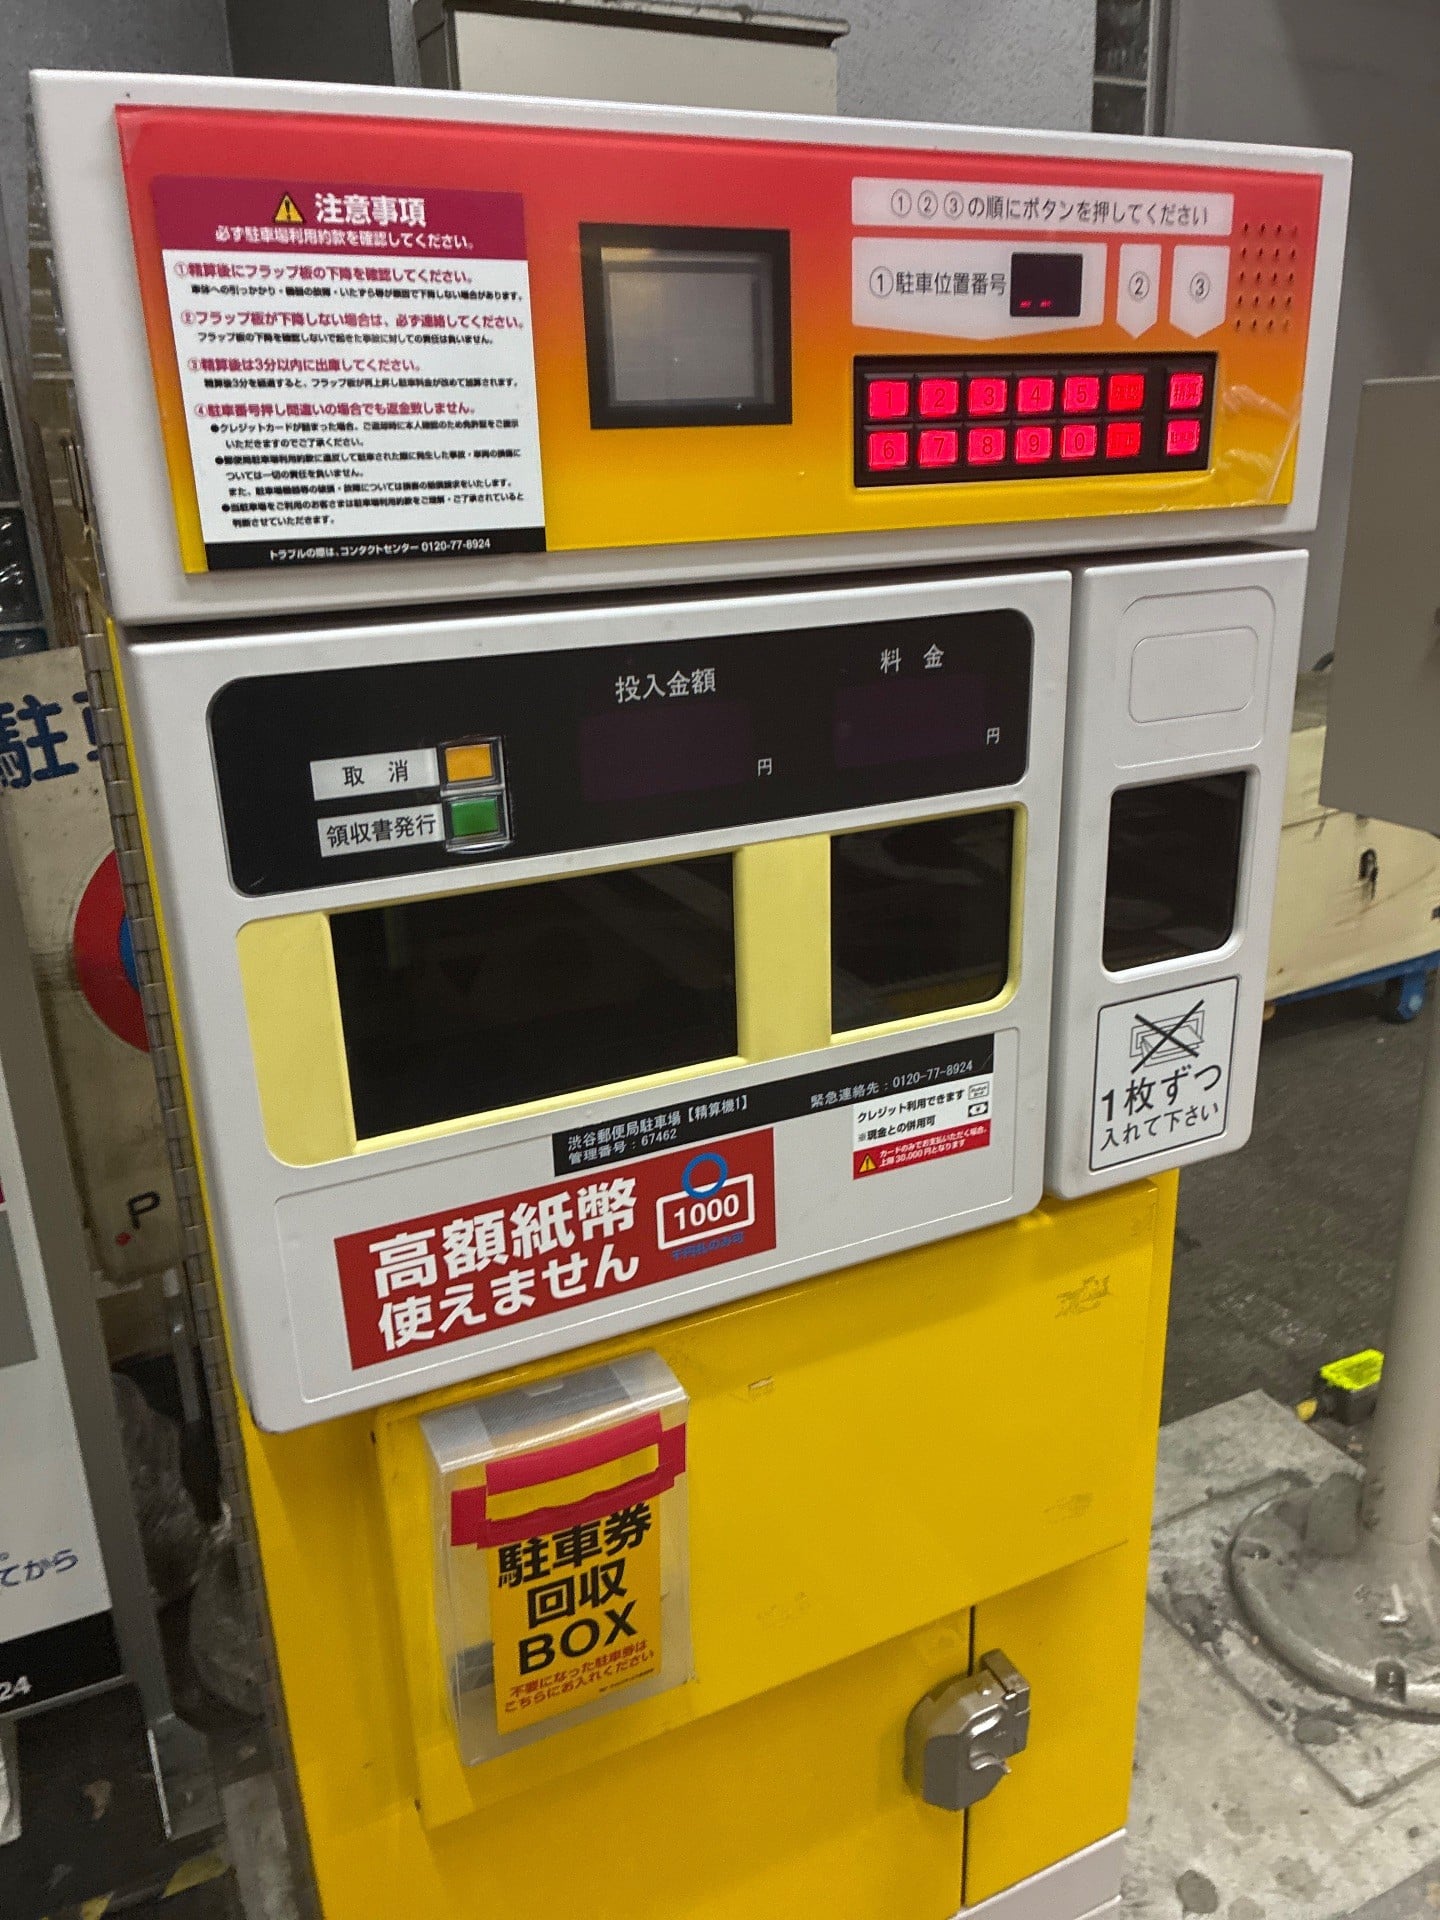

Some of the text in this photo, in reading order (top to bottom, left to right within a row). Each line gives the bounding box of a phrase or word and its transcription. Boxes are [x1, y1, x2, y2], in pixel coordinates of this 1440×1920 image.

[315, 193, 426, 227] 注意事項
[869, 265, 1007, 298] ①駐車位置番号
[884, 388, 894, 410] 1
[934, 387, 946, 408] 2
[983, 385, 995, 407] 3
[1029, 383, 1042, 404] 4
[1075, 382, 1087, 403] 5
[882, 438, 896, 461] 6
[933, 436, 946, 458] 7
[981, 434, 994, 456] 8
[1028, 433, 1040, 454] 9
[421, 538, 491, 554] 0120-77-8924
[614, 667, 717, 703] 投入金額
[986, 727, 1001, 746] 円
[758, 756, 773, 777] 円
[326, 812, 437, 848] 領収書発行
[857, 1087, 965, 1123] クレジット利用できます
[1101, 1063, 1222, 1122] 1枚ずつ
[1100, 1101, 1219, 1152] 入れて下さい
[128, 1191, 161, 1230] P
[673, 1193, 740, 1231] 1000
[369, 1176, 638, 1300] 高額紙幣
[378, 1254, 640, 1353] 使えません
[498, 1502, 652, 1588] 駐車券
[527, 1557, 628, 1631] 回収
[519, 1600, 637, 1676] BOX
